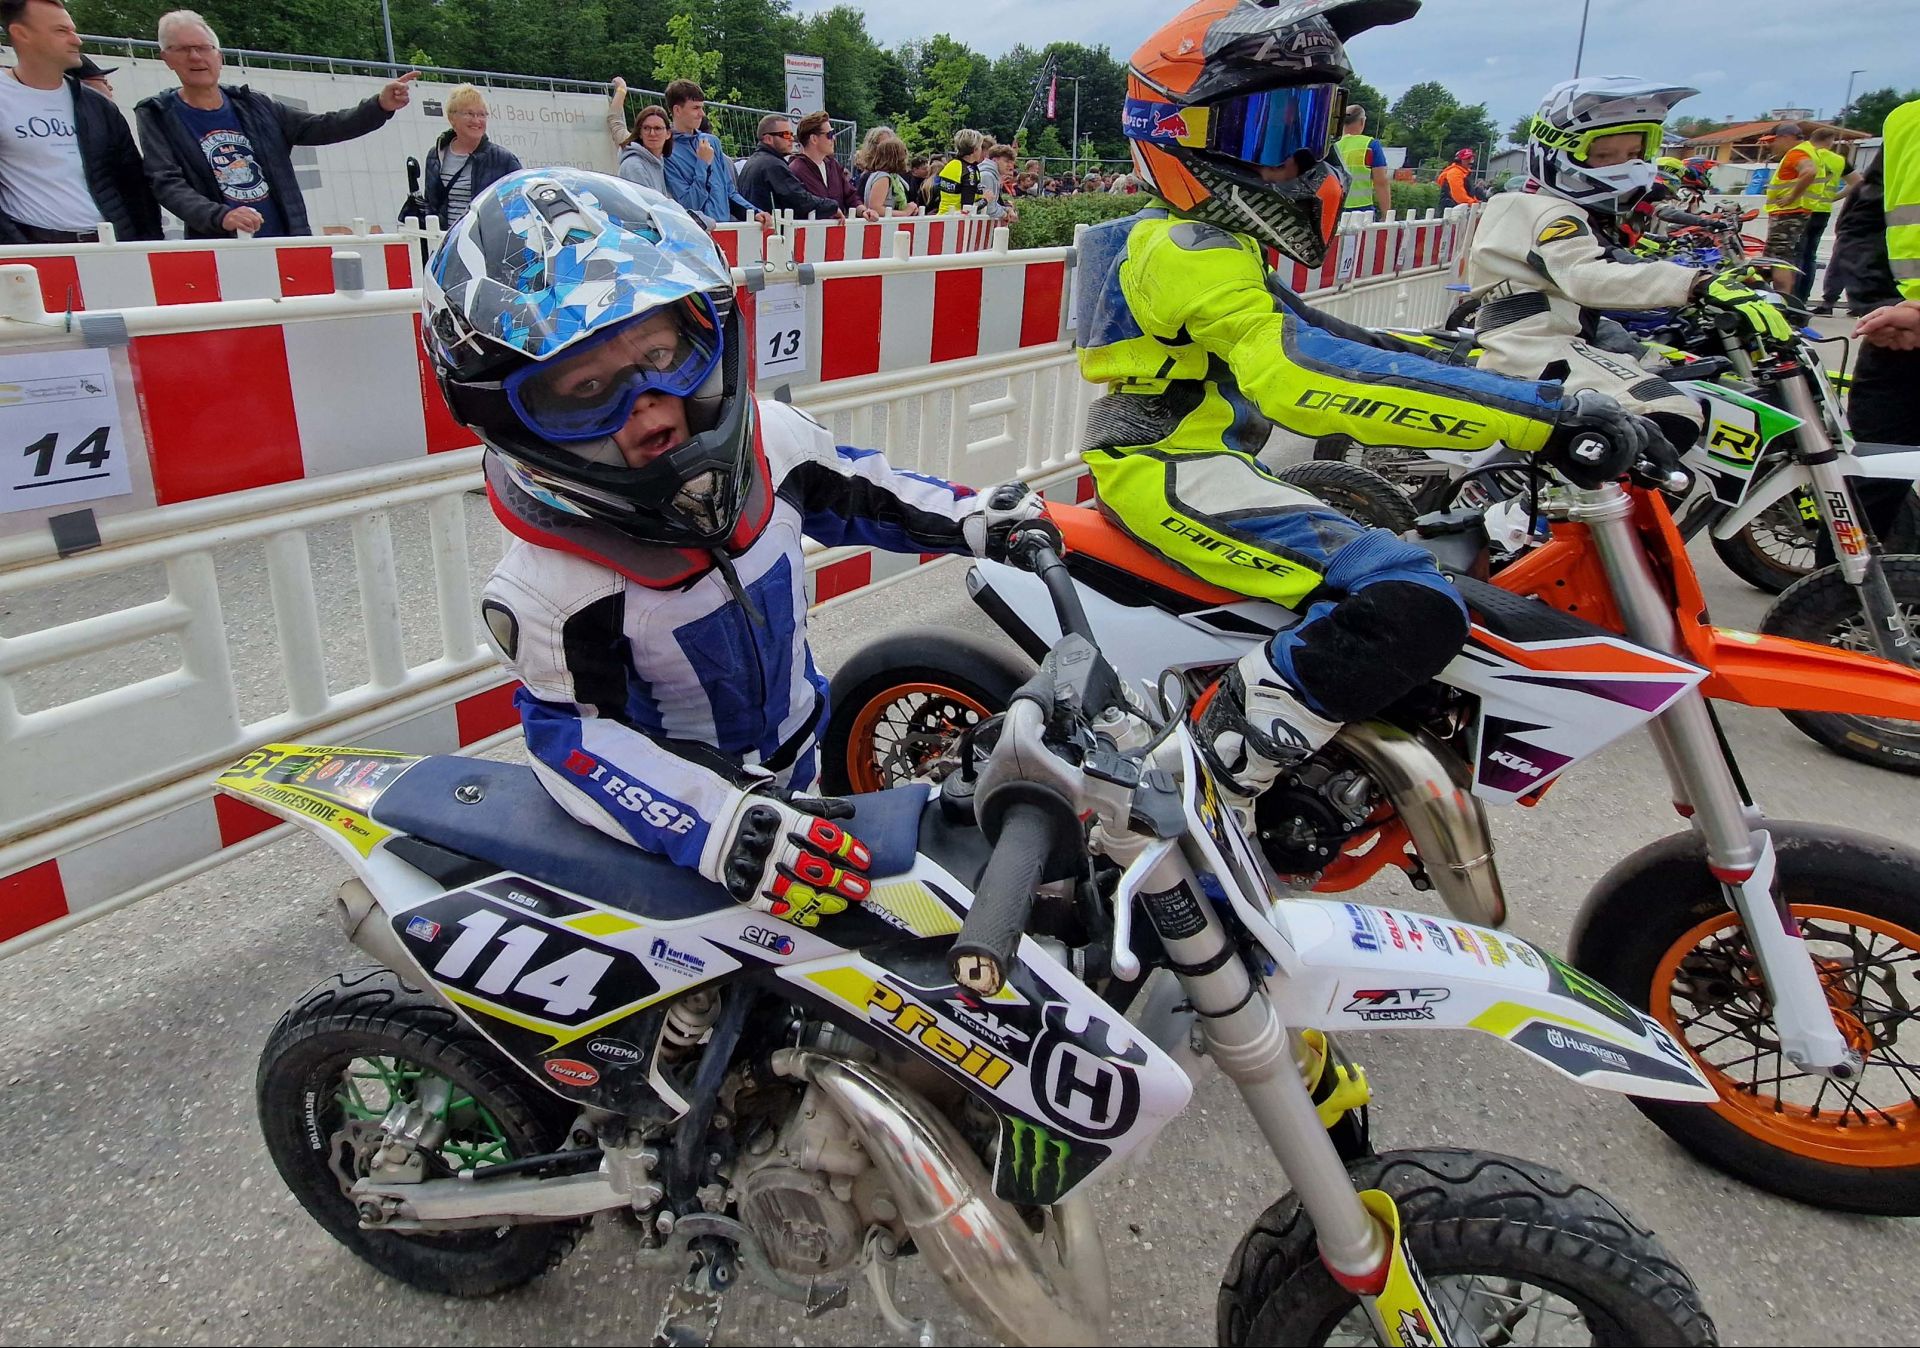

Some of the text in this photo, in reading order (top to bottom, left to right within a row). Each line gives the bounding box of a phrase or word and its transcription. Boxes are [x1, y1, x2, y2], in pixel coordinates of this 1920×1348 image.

[507, 105, 535, 121] Bau
[540, 107, 586, 123] GmbH
[1531, 120, 1581, 149] 100%
[1343, 257, 1352, 270] 10
[769, 329, 801, 358] 13
[1294, 389, 1487, 440] DAINESE
[23, 426, 111, 477] 14
[1159, 516, 1295, 578] DAINESE
[1487, 750, 1544, 778] KTM
[251, 782, 340, 822] BRIDGESTONE
[564, 748, 697, 835] BIESSE
[507, 891, 540, 908] OSSI
[1173, 898, 1189, 911] bar
[743, 925, 779, 948] elf
[433, 909, 616, 1016] 114
[667, 947, 683, 960] Karl
[1343, 987, 1451, 1013] ZAP
[951, 1007, 1010, 1050] TECHNIX
[1358, 1007, 1436, 1022] TECHNIX
[863, 980, 1014, 1090] Pfeil
[1565, 1035, 1628, 1063] Husqvarna
[591, 1042, 639, 1060] ORTEMA
[550, 1063, 596, 1081] Twin Air
[1053, 1049, 1115, 1124] H
